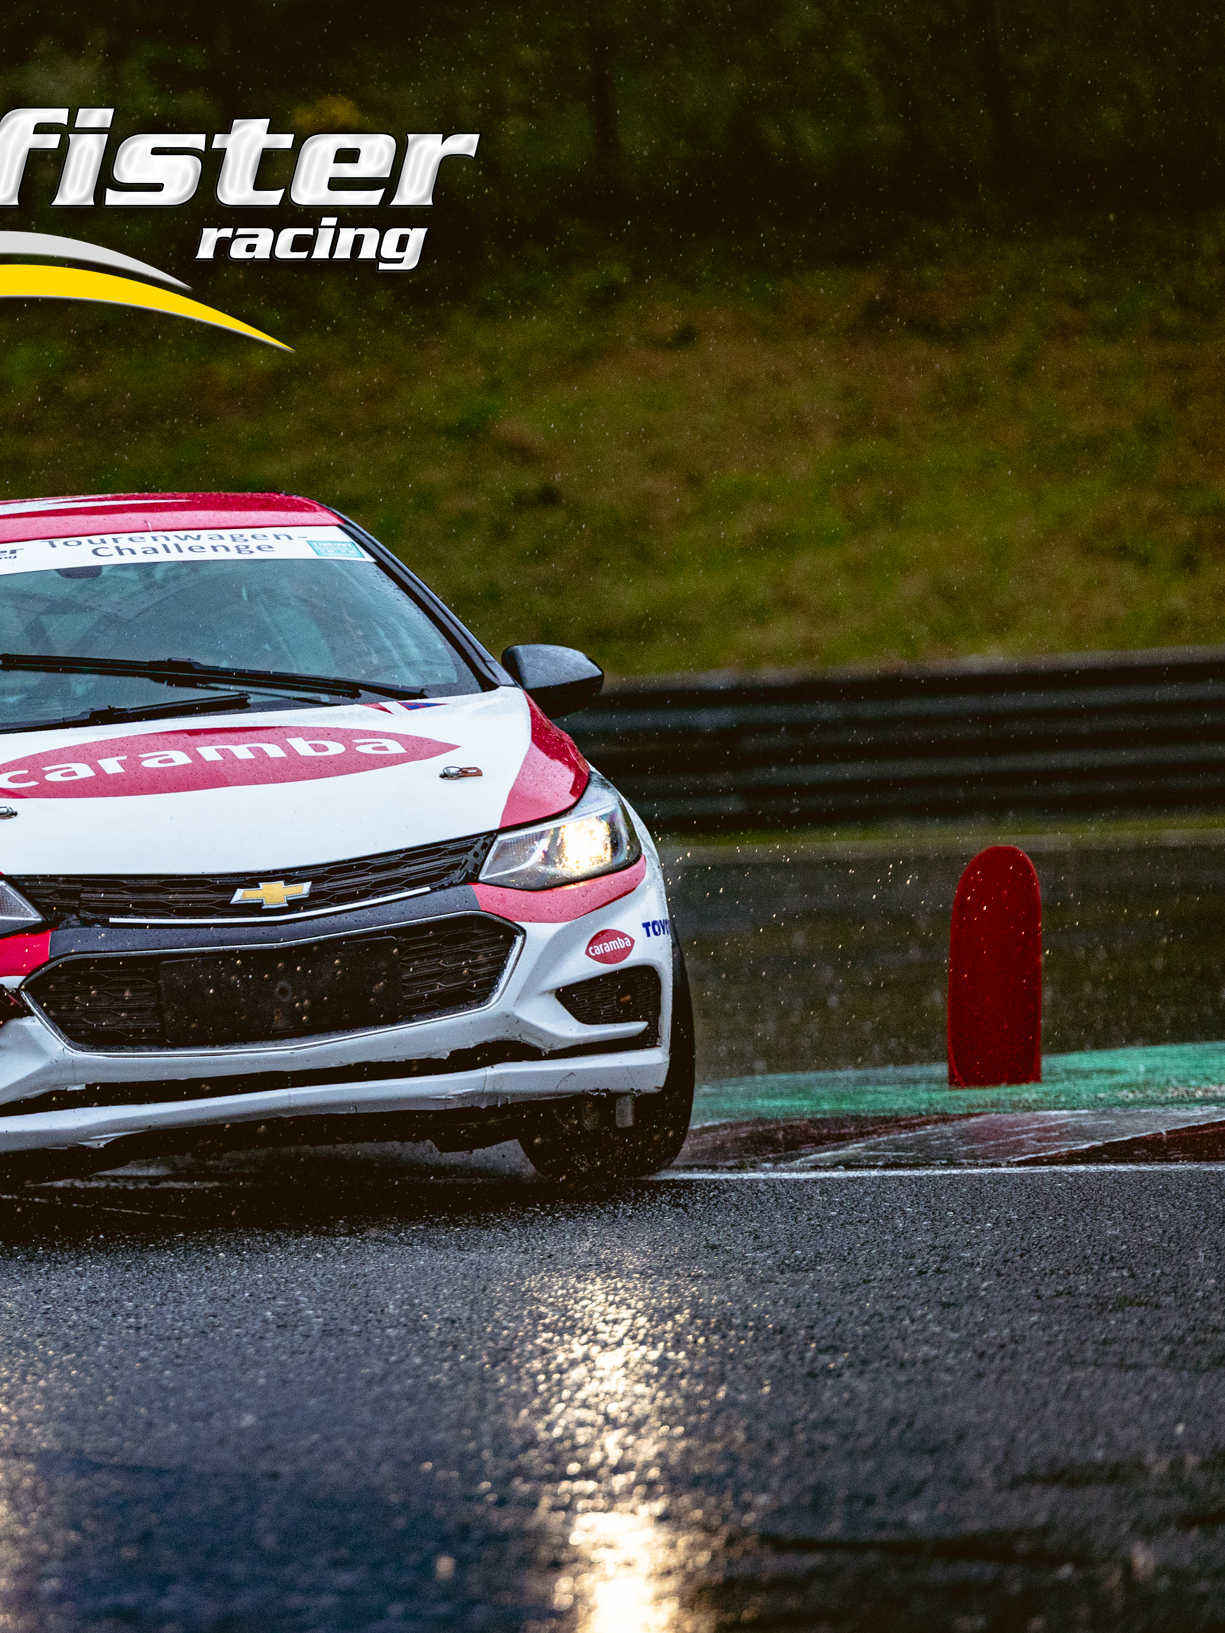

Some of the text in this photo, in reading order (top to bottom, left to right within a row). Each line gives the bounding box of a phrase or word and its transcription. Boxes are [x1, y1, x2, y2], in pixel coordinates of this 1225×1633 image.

[40, 532, 307, 549] Tourenwagen-
[91, 542, 275, 556] Challenge
[588, 936, 631, 956] caramba
